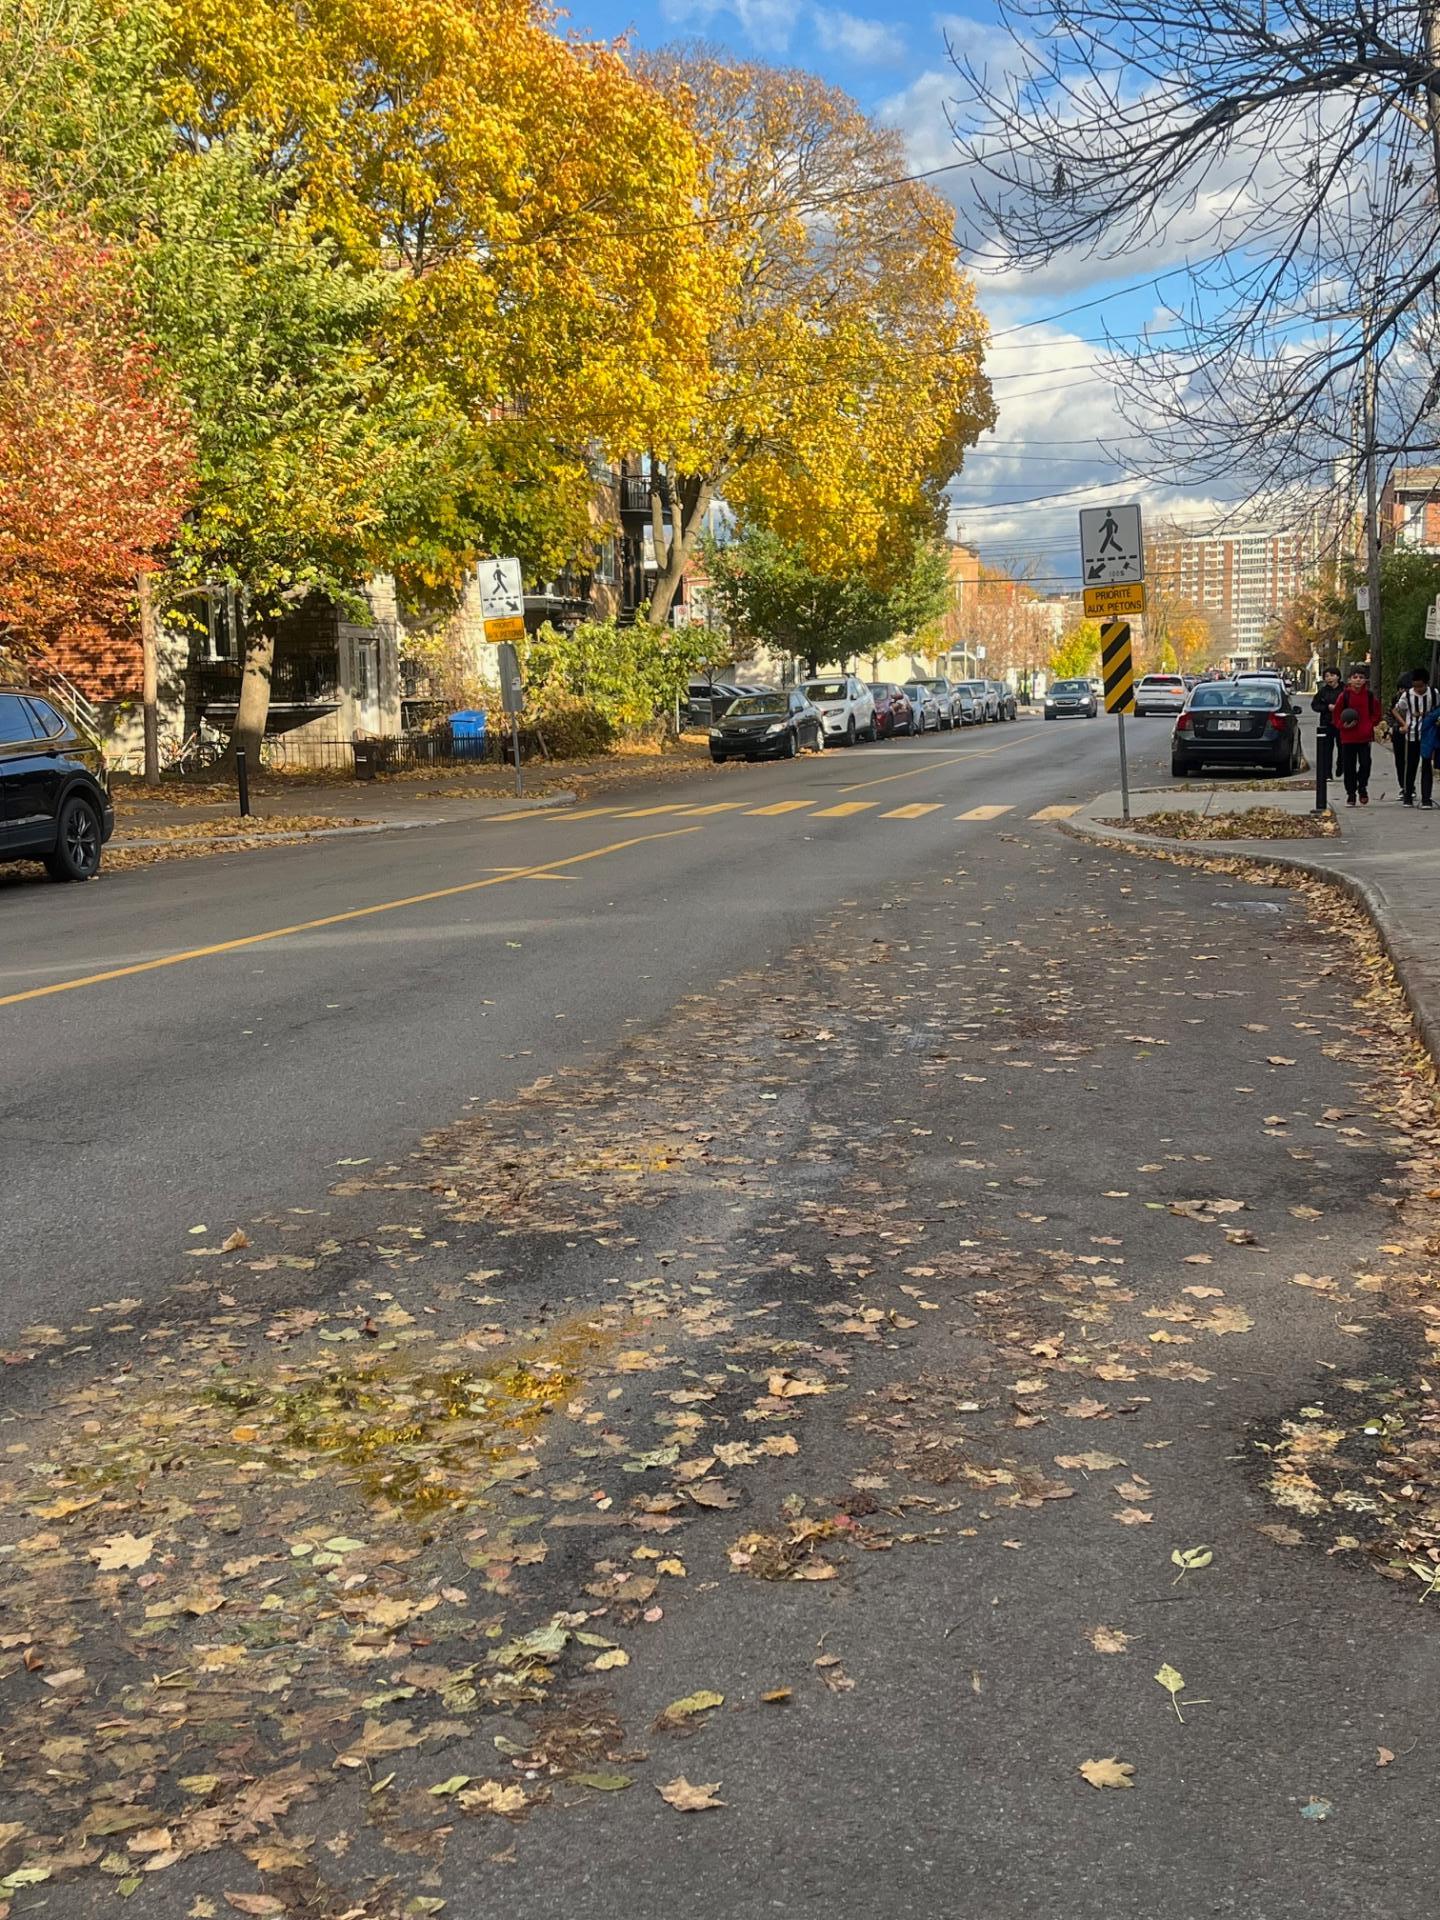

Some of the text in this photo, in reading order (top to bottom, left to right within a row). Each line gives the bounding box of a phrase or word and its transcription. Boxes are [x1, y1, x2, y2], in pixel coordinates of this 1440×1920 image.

[1095, 588, 1132, 600] PRIORITÉ
[1088, 600, 1142, 613] AUX PIÉTONS
